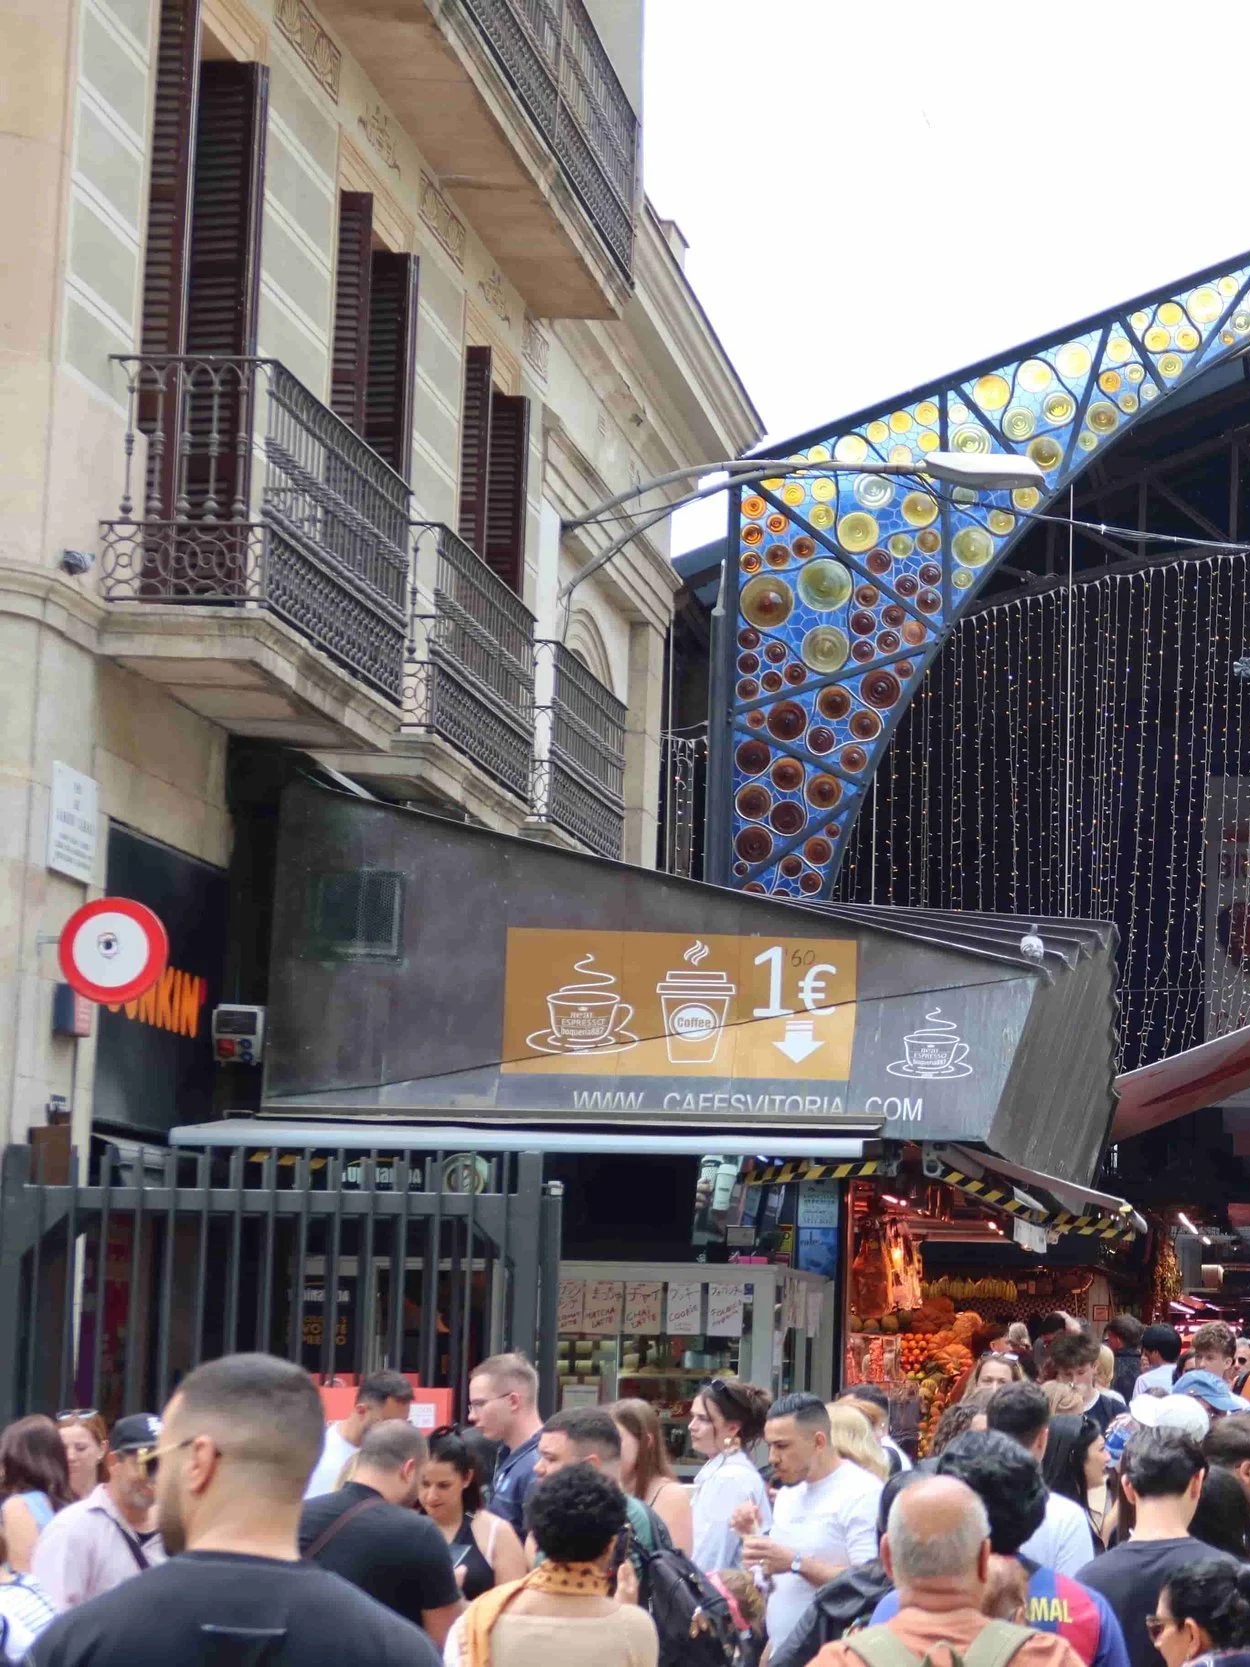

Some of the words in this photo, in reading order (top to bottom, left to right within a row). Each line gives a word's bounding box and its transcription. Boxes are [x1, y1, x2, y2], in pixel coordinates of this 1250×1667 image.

[676, 1016, 712, 1028] Coffee
[573, 1090, 644, 1110] WWW
[865, 1096, 923, 1121] COM
[1027, 1596, 1073, 1623] MAL
